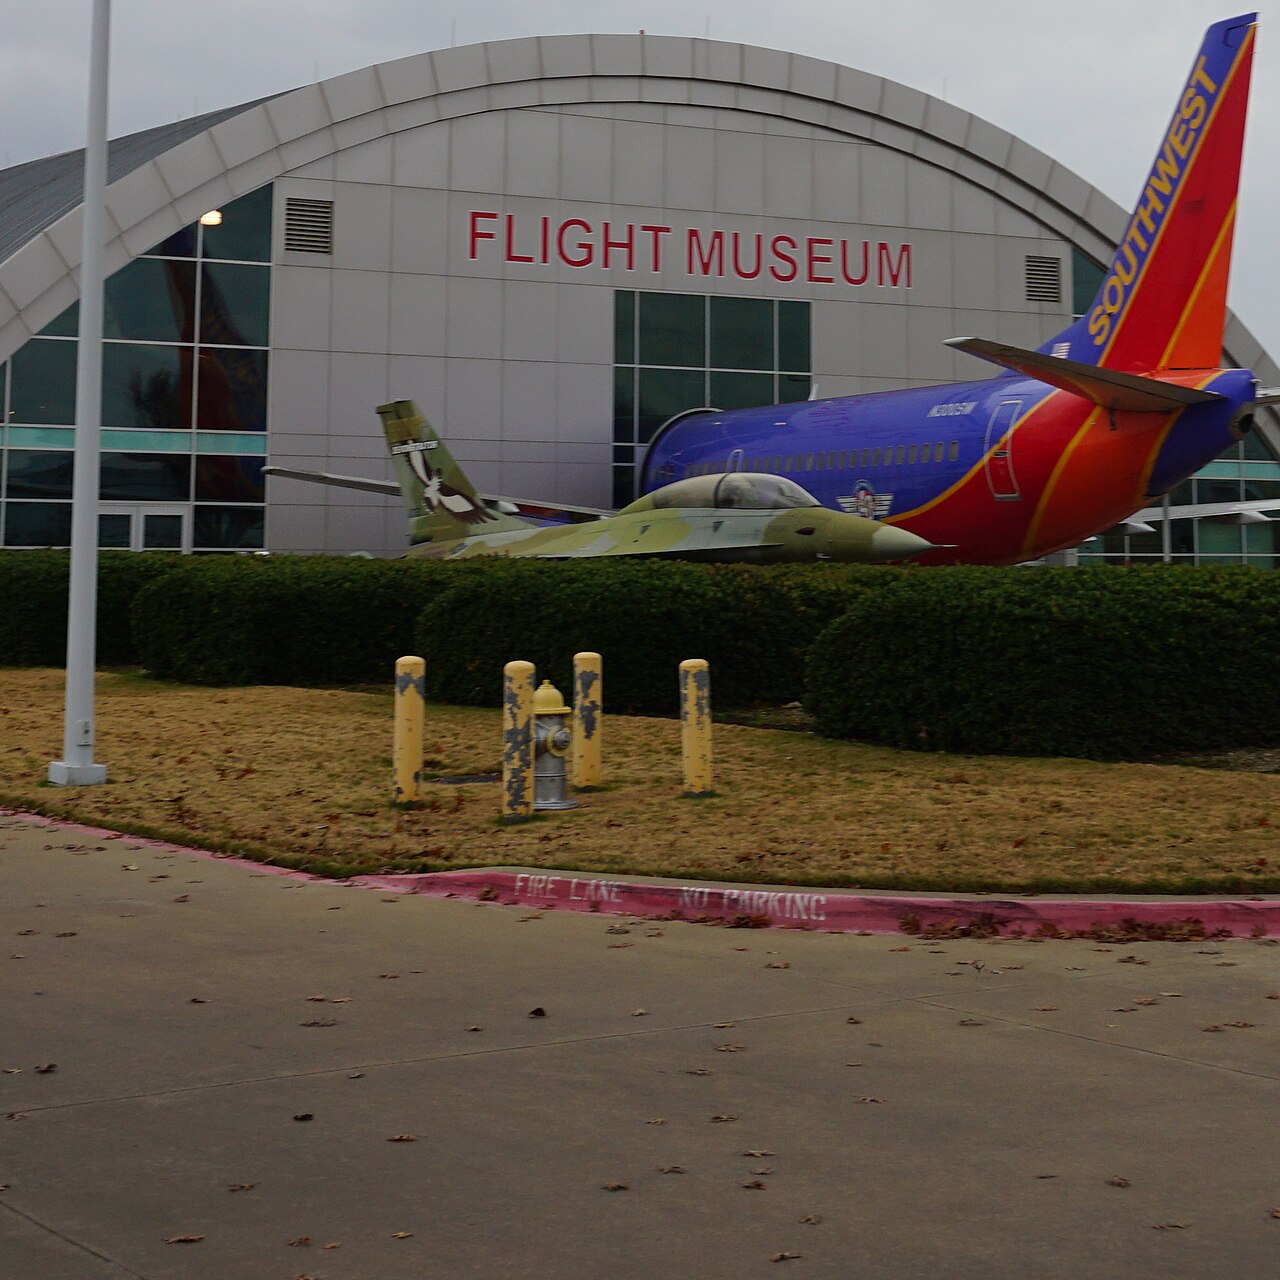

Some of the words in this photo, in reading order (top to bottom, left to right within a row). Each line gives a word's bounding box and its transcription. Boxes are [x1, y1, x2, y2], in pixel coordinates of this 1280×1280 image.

[1088, 55, 1217, 346] SOUTHWEST
[468, 211, 672, 273] FLIGHT
[686, 228, 914, 289] MUSEUM
[514, 873, 561, 899] FIRE
[569, 878, 624, 902] LANE
[677, 887, 710, 909] NO
[722, 889, 827, 921] PARKING
